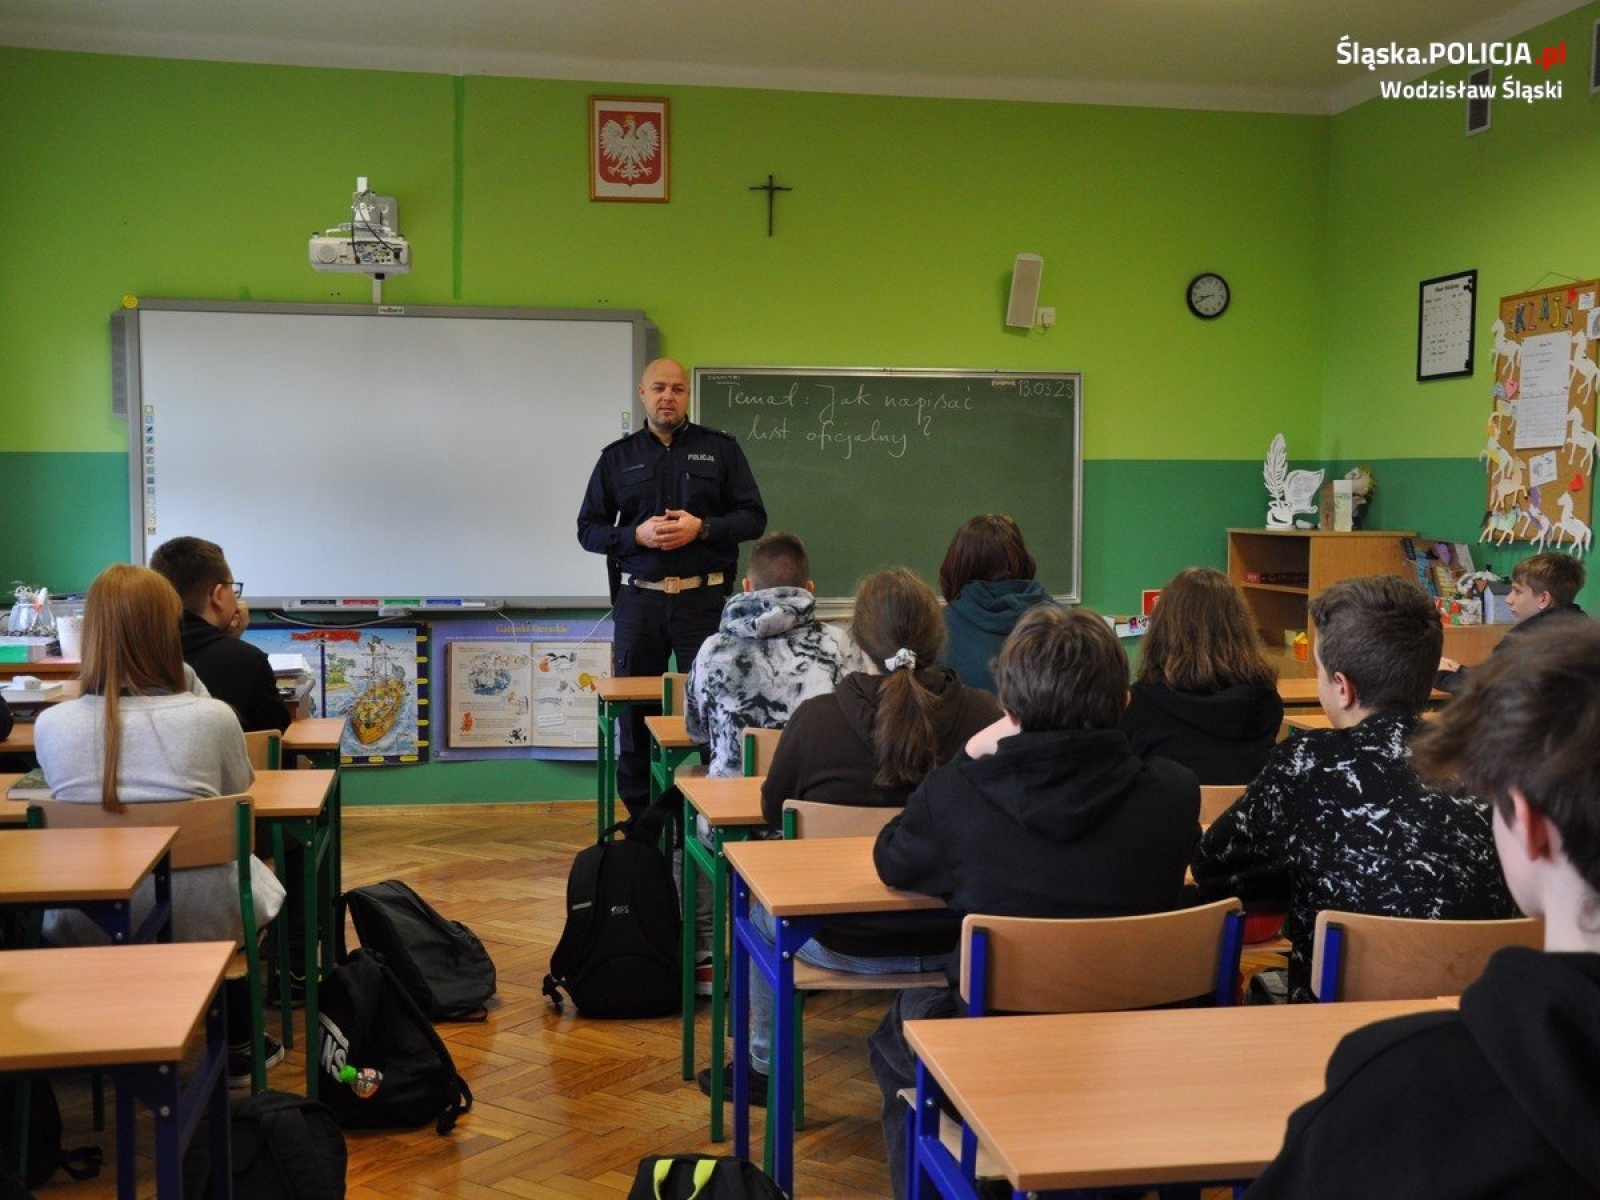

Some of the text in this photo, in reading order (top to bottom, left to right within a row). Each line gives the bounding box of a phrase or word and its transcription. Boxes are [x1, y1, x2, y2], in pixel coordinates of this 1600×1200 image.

[815, 384, 872, 423] Jak
[885, 386, 974, 426] napisać
[747, 415, 790, 440] list
[687, 453, 715, 462] POLICJA
